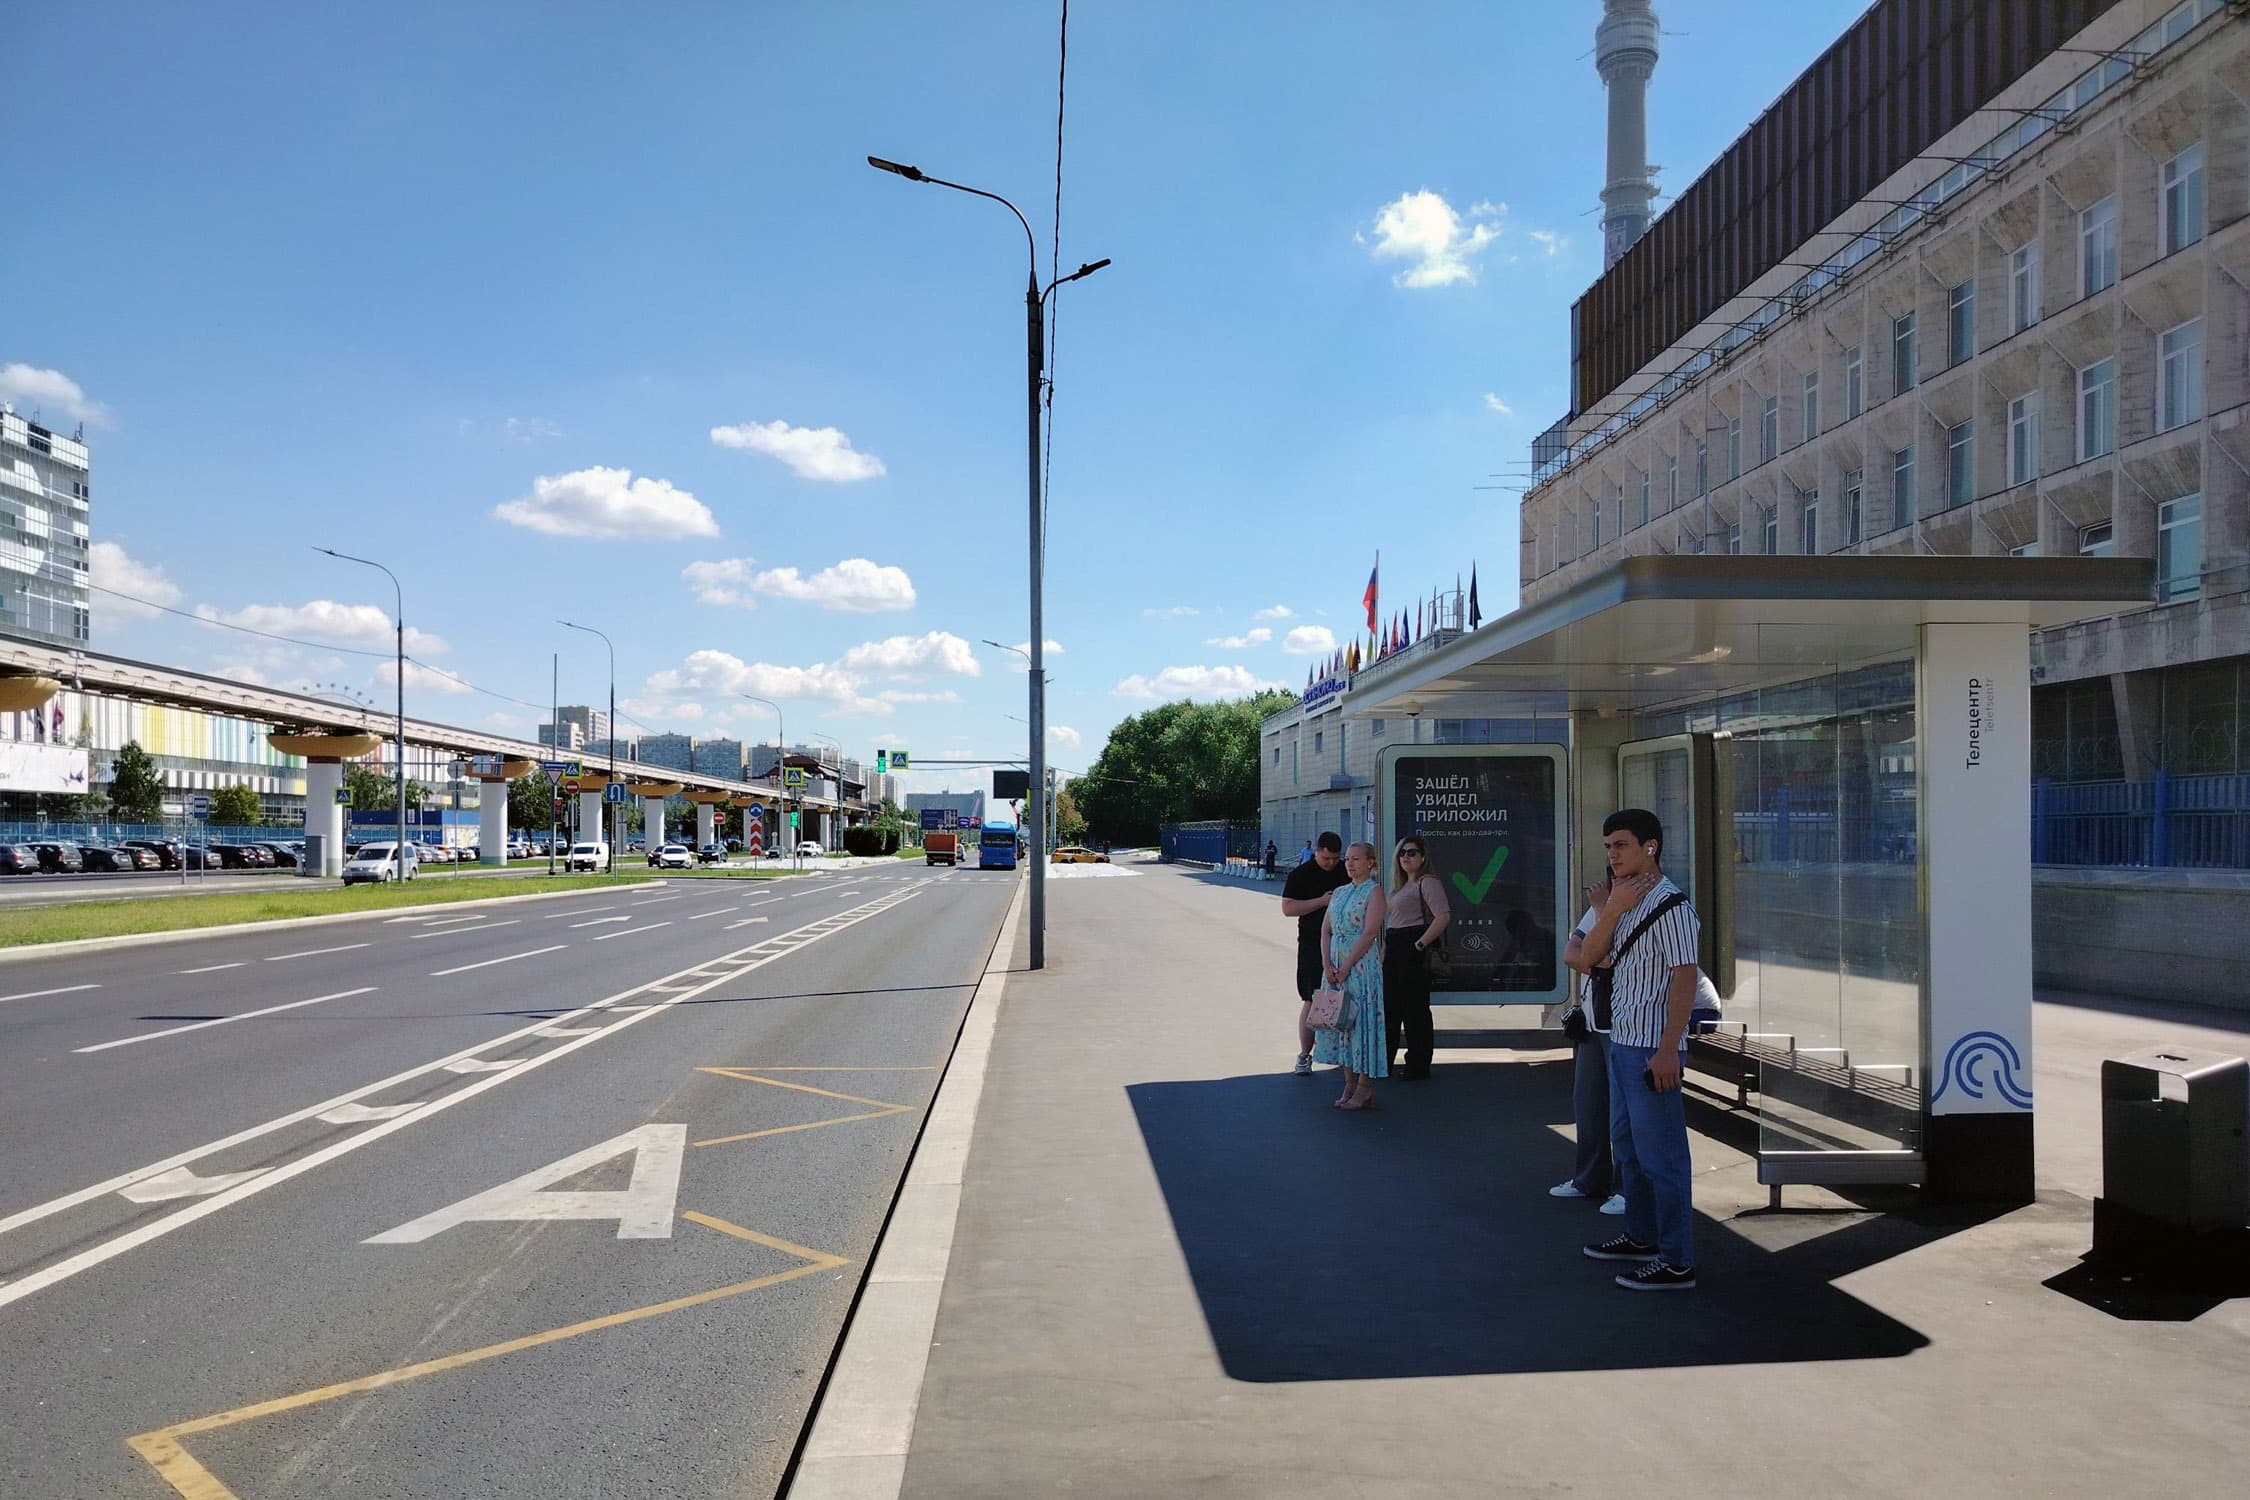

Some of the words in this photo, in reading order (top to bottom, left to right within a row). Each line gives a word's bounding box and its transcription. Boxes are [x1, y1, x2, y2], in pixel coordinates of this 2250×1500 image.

[1966, 678, 1982, 769] Телецентр
[1415, 774, 1469, 790] ЗАШЁЛ
[1415, 793, 1478, 808] УВИДЕЛ
[1415, 809, 1508, 822] ПРИЛОЖИЛ
